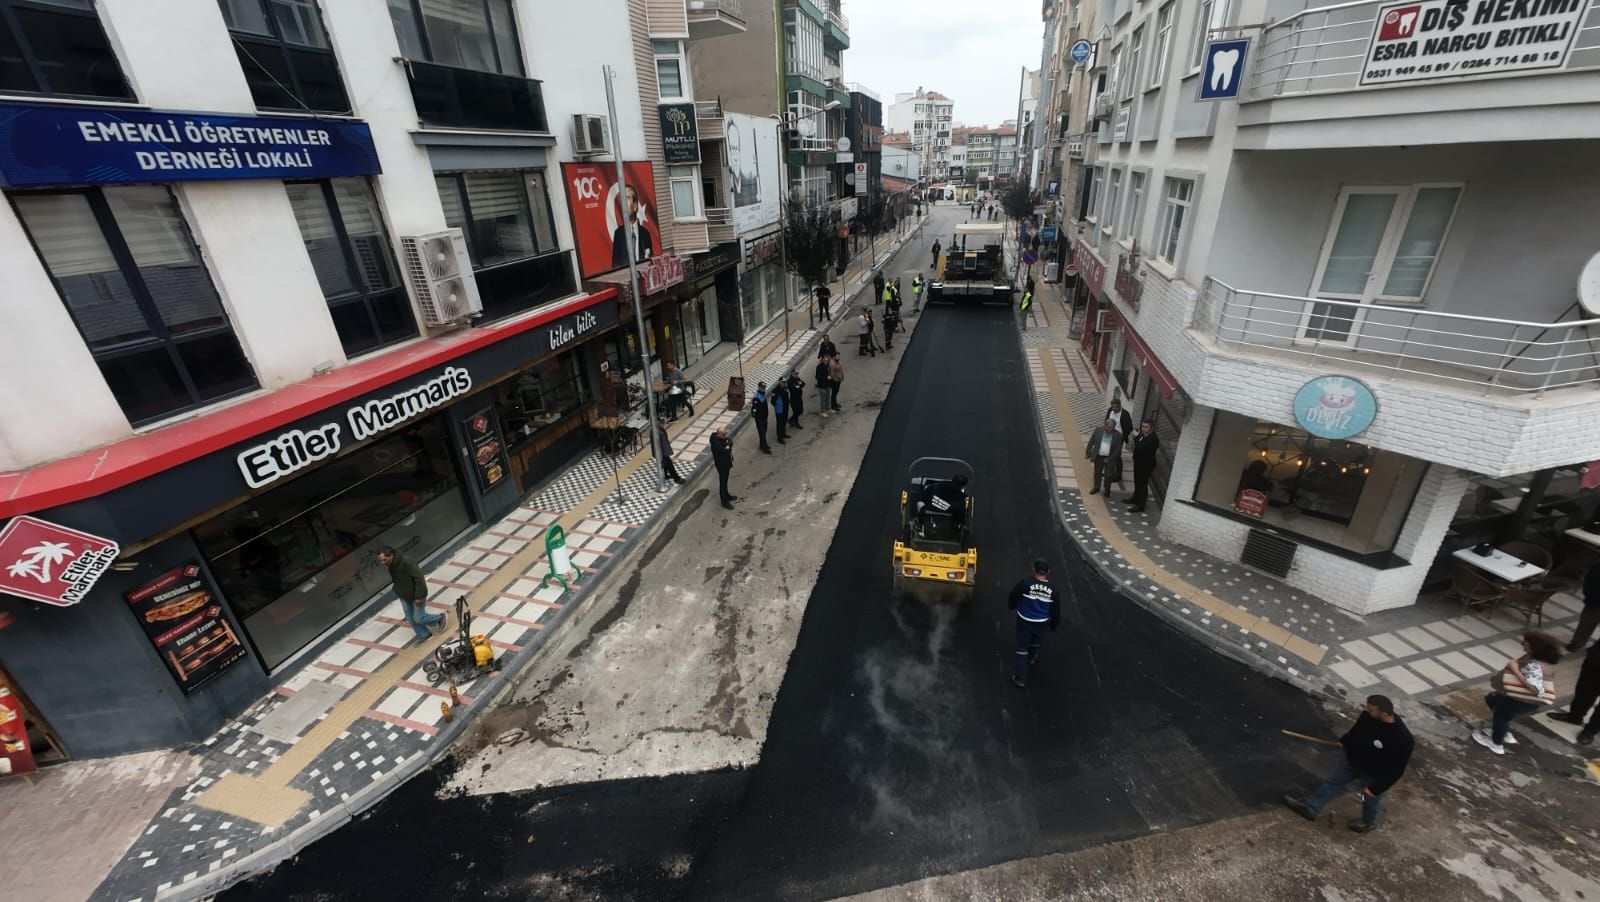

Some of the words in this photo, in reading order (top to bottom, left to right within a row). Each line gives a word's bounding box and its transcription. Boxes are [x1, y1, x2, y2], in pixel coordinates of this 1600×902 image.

[1373, 40, 1417, 62] ESRA
[1422, 32, 1492, 57] NARCU
[78, 120, 181, 144] EMEKLİ
[185, 120, 332, 146] ÖĞRETMENLER
[136, 148, 243, 171] DERNEĞİ
[245, 148, 312, 169] LOKALİ
[550, 325, 575, 350] bilen
[577, 311, 597, 334] bilir
[241, 424, 339, 486] Etiler
[350, 369, 470, 438] Marmaris
[61, 551, 95, 582] Etiler
[62, 547, 117, 602] Marmaris
